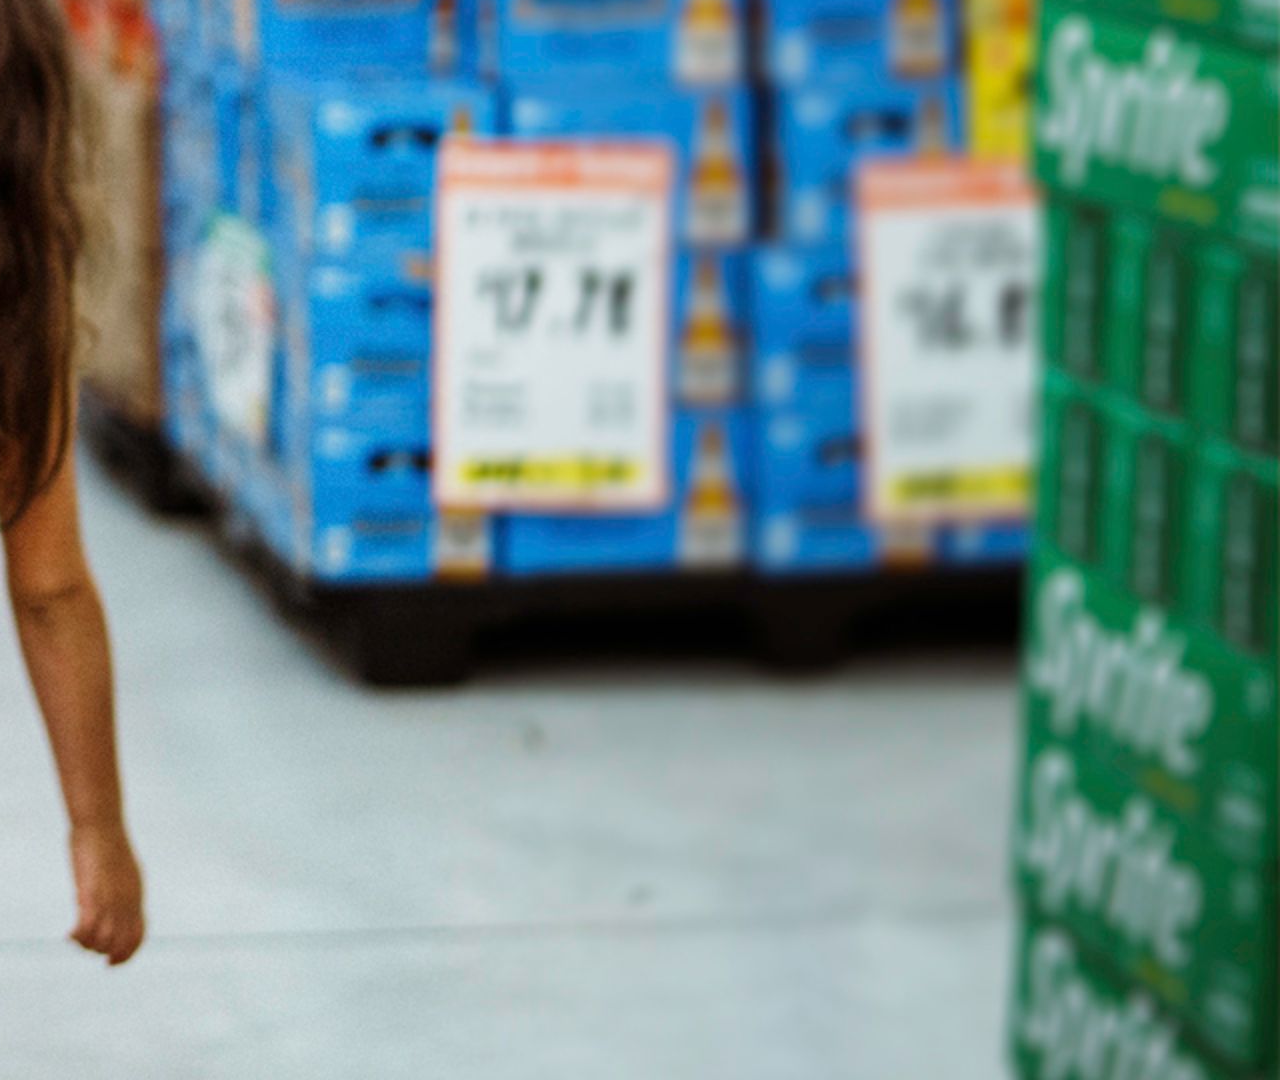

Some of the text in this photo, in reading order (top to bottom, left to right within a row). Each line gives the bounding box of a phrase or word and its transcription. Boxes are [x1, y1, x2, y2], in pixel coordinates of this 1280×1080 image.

[1042, 19, 1228, 186] Sprite
[1030, 566, 1212, 776] Sprite
[1028, 750, 1201, 968] Sprite
[1028, 929, 1204, 1080] Sprit
